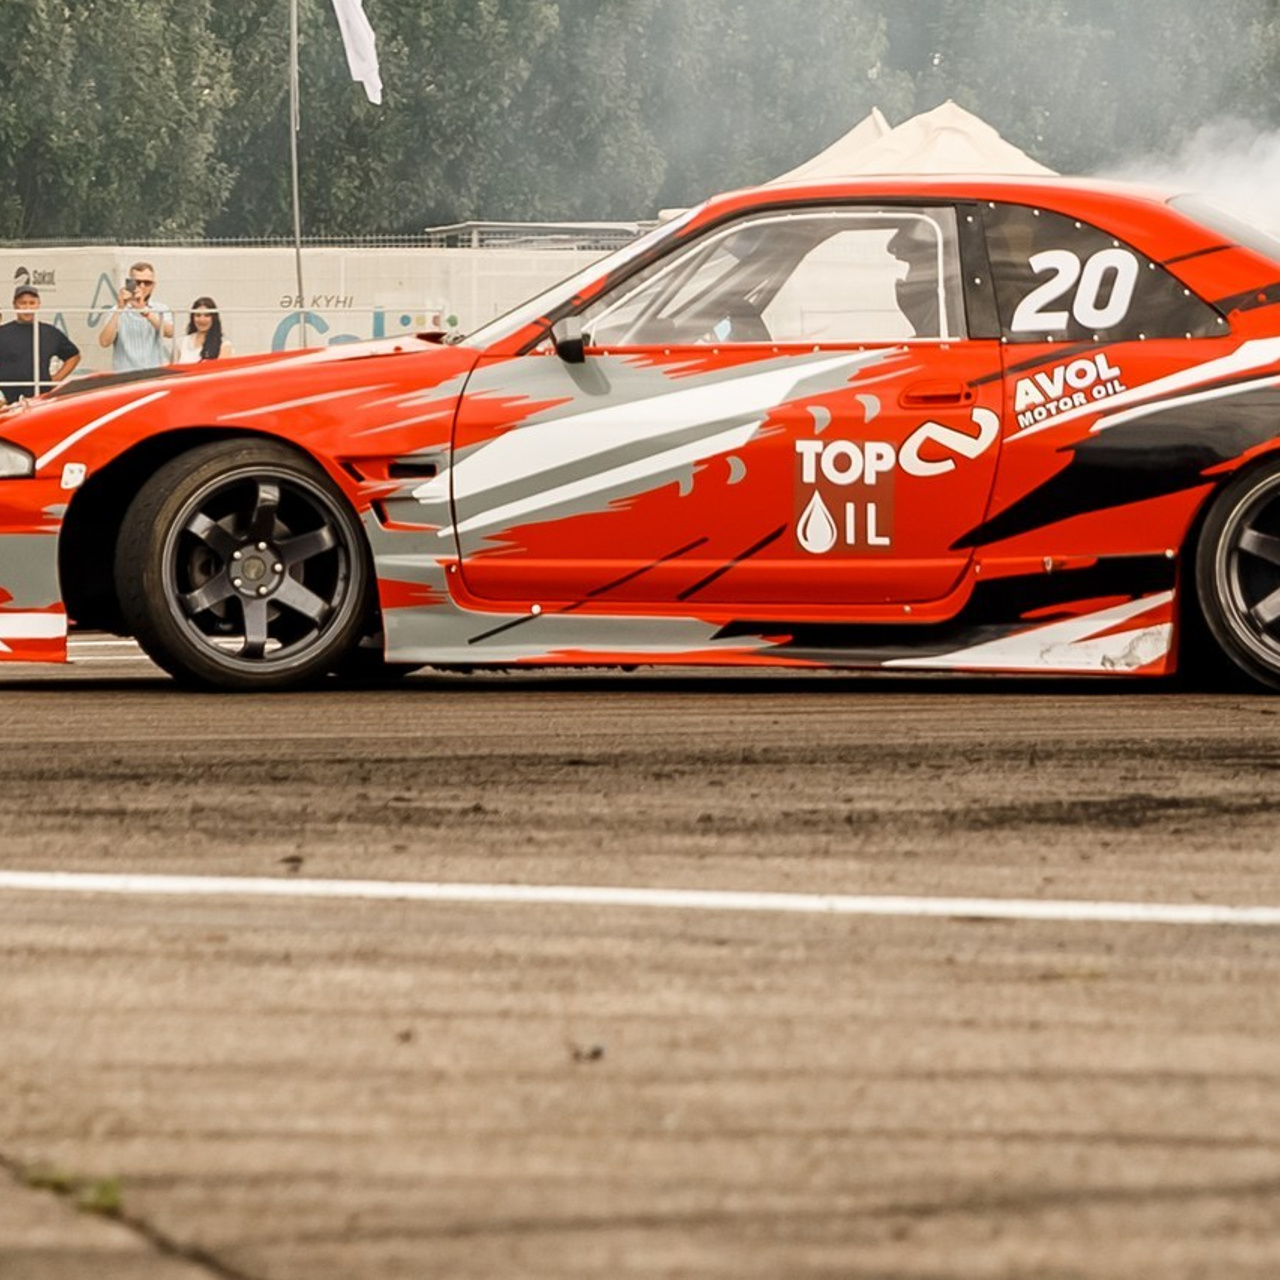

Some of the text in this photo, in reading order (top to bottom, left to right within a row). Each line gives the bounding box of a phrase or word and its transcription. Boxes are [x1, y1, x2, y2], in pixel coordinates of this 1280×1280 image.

[1010, 248, 1139, 332] 20
[1014, 353, 1120, 411] AVOL
[1017, 379, 1127, 429] MOTOR OIL
[795, 439, 896, 485] TOP
